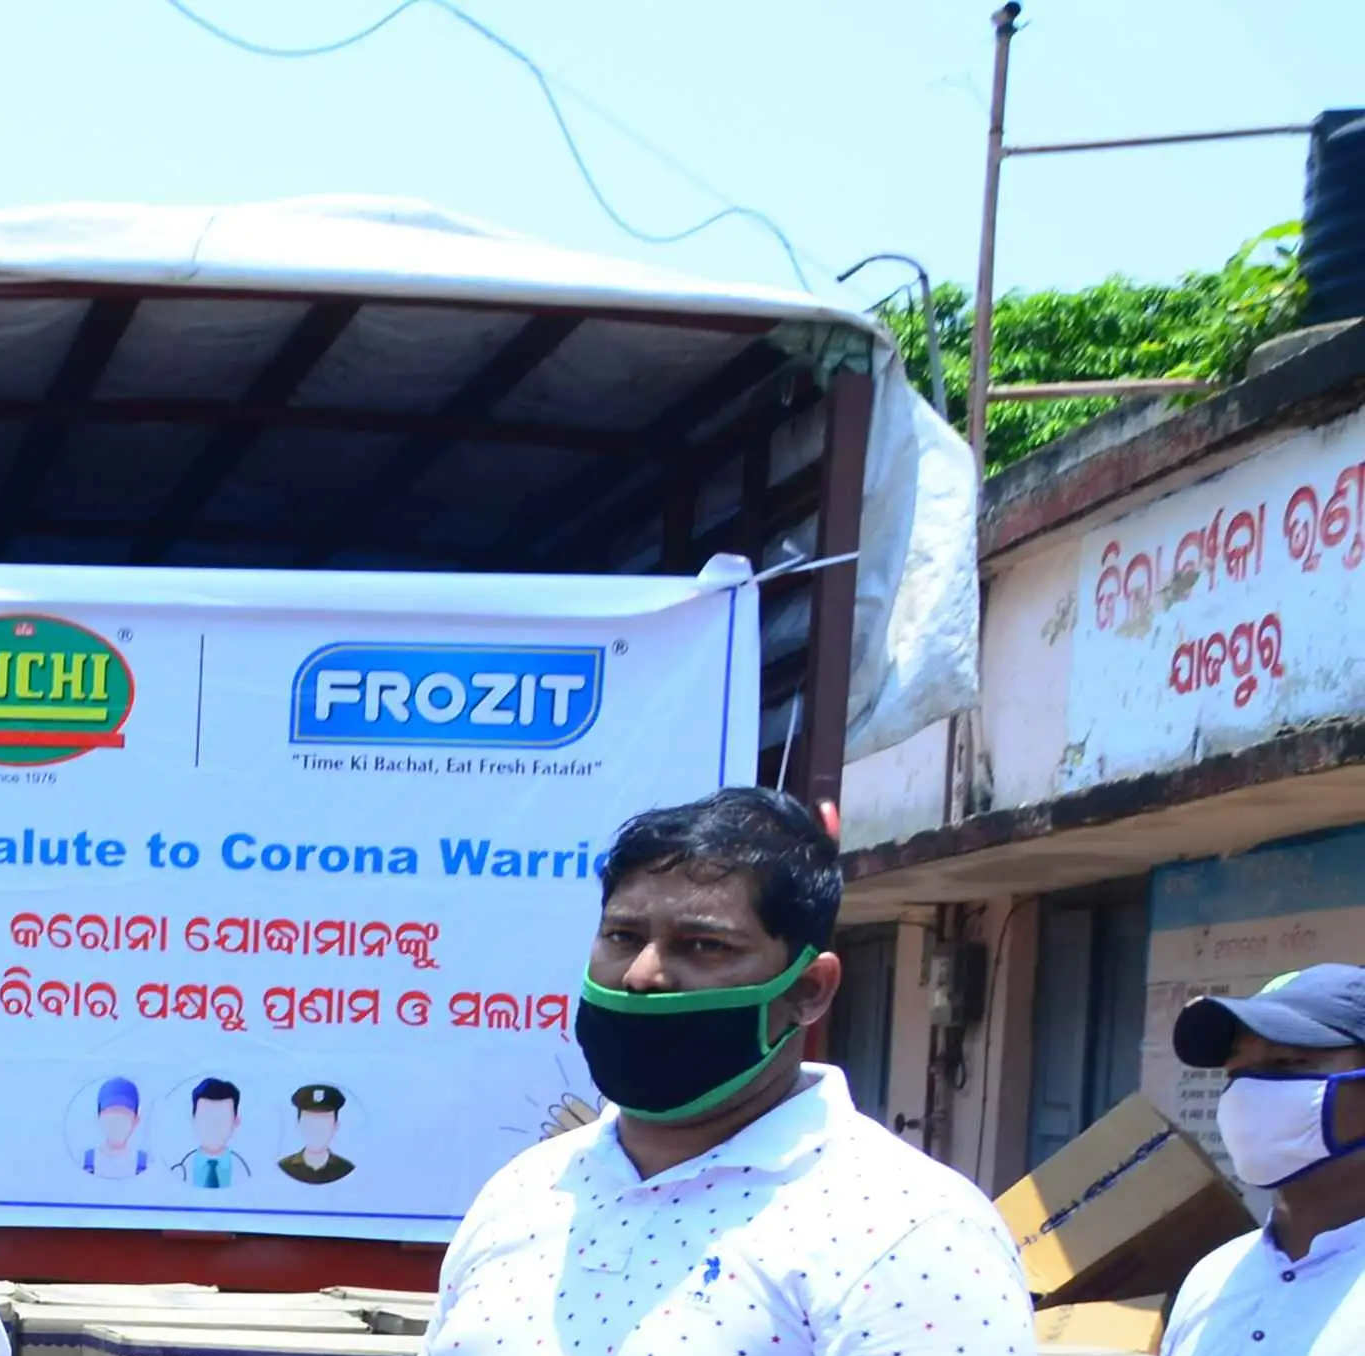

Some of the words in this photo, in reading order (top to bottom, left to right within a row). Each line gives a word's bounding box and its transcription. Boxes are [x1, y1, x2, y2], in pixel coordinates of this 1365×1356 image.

[315, 669, 586, 727] FROZIT
[25, 771, 56, 784] 1976
[350, 755, 367, 771] Ki
[374, 755, 439, 774] Bachat,
[446, 758, 471, 773] Eat
[479, 759, 525, 775] Fresh
[146, 832, 200, 869] to
[221, 832, 418, 875] Corona
[10, 912, 168, 952] କରୋନା
[137, 981, 247, 1031] ପକ୍ଷରୁ
[263, 985, 380, 1029] ପ୍ରଣାମ
[396, 990, 430, 1026] ଓ
[449, 992, 570, 1042] ସଲାମ୍
